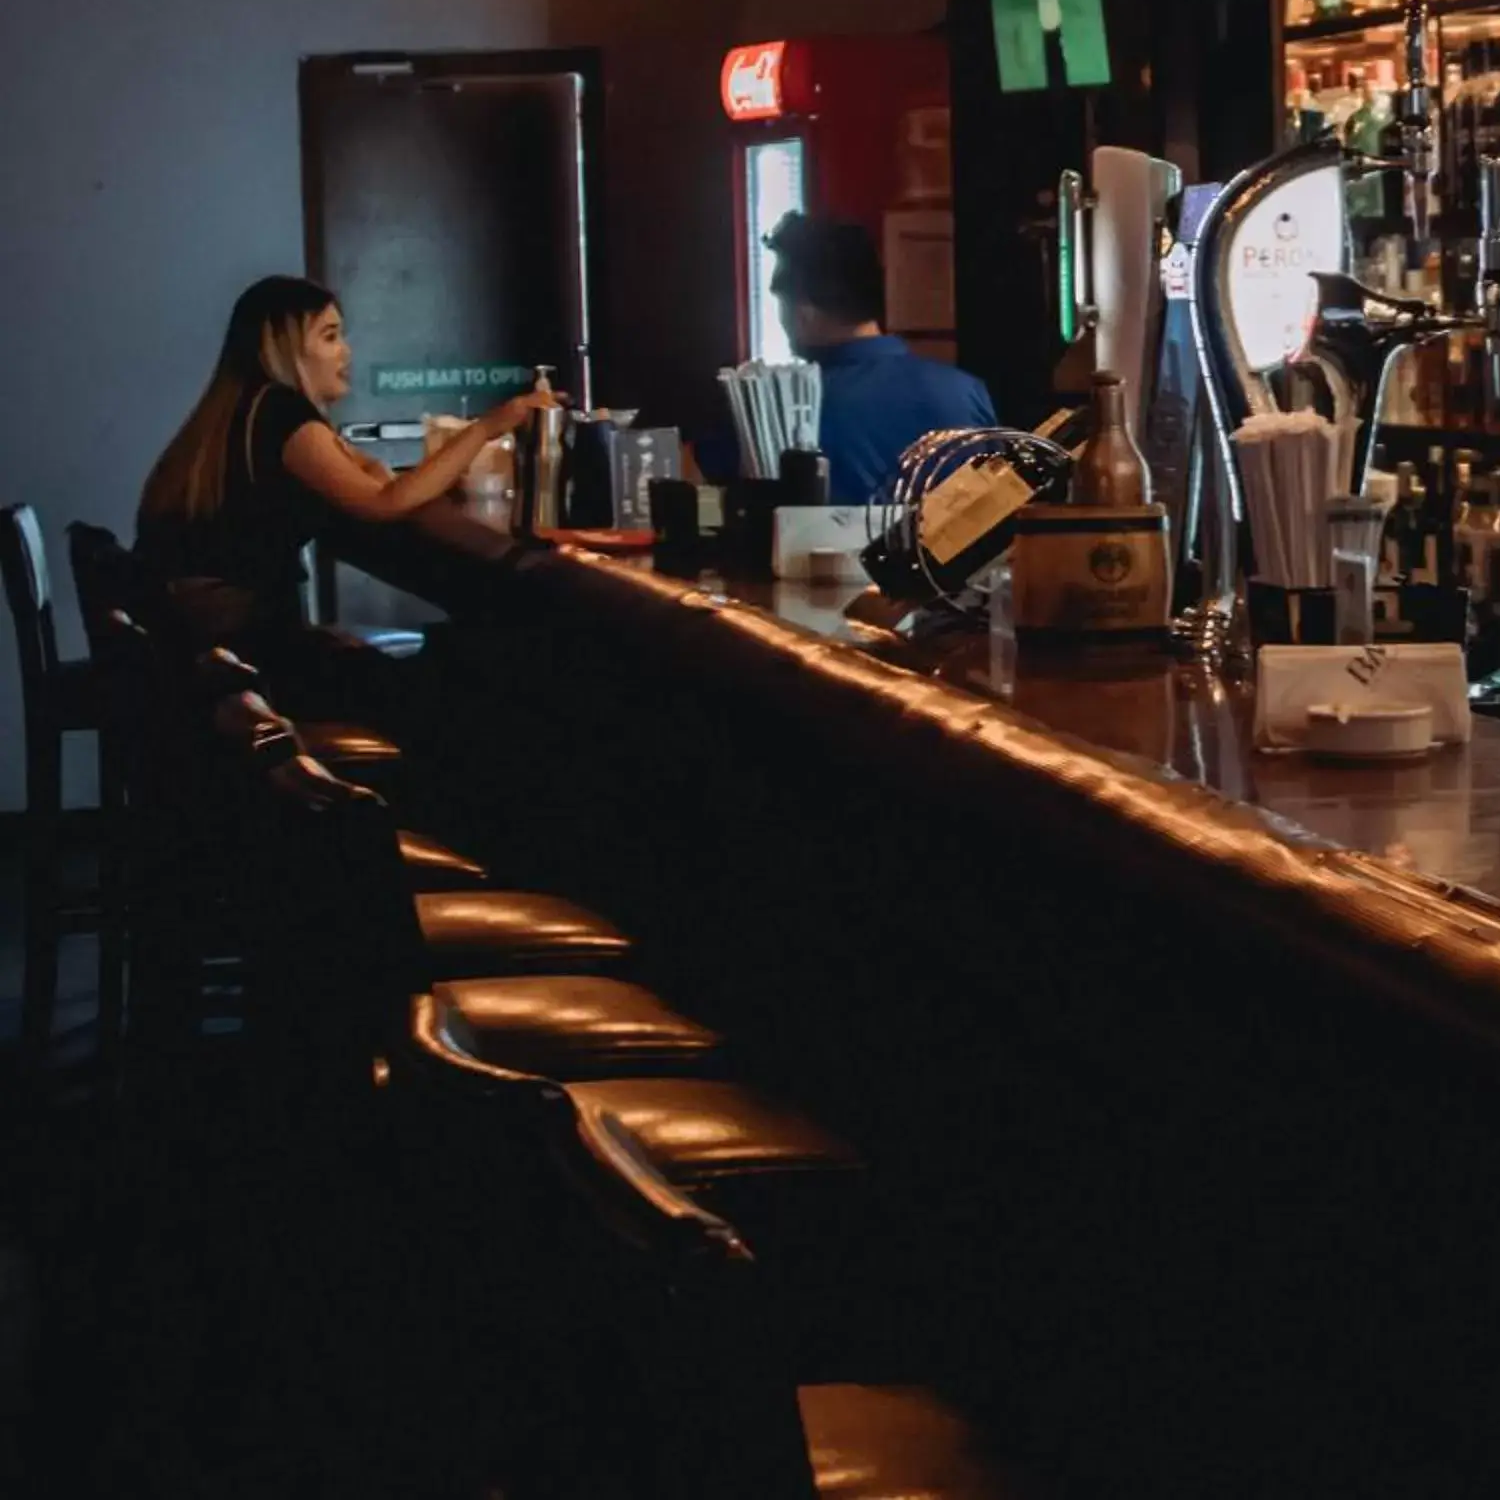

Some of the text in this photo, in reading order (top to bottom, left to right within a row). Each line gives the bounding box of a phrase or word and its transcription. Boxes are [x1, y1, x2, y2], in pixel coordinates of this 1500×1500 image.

[377, 369, 423, 389] PUSH
[427, 367, 461, 386] BAR
[464, 366, 486, 385] TO
